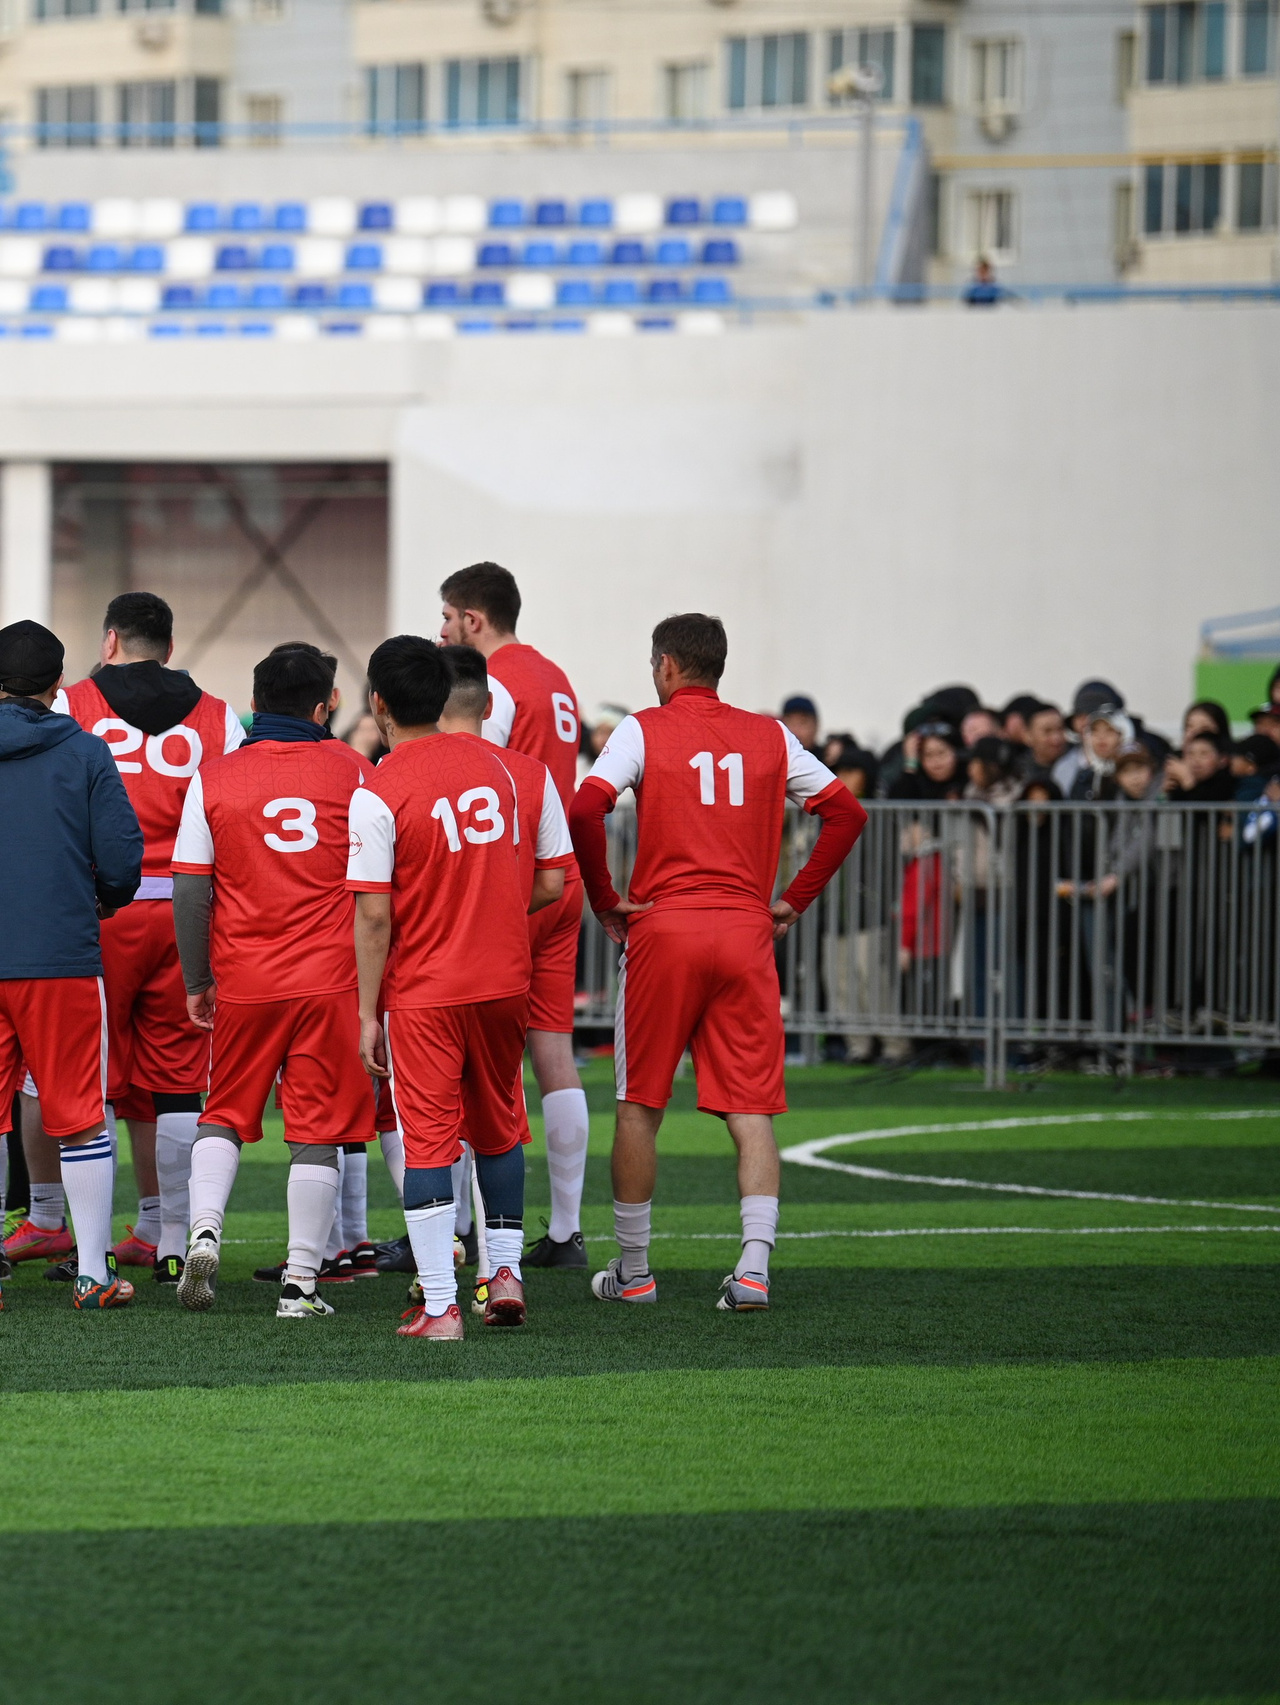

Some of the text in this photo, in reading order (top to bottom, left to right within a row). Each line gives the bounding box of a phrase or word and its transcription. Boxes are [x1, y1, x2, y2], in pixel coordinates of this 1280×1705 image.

[551, 692, 578, 743] 6
[91, 717, 203, 777] 20
[688, 751, 744, 807] 11
[262, 797, 319, 853] 3
[430, 786, 505, 853] 13
